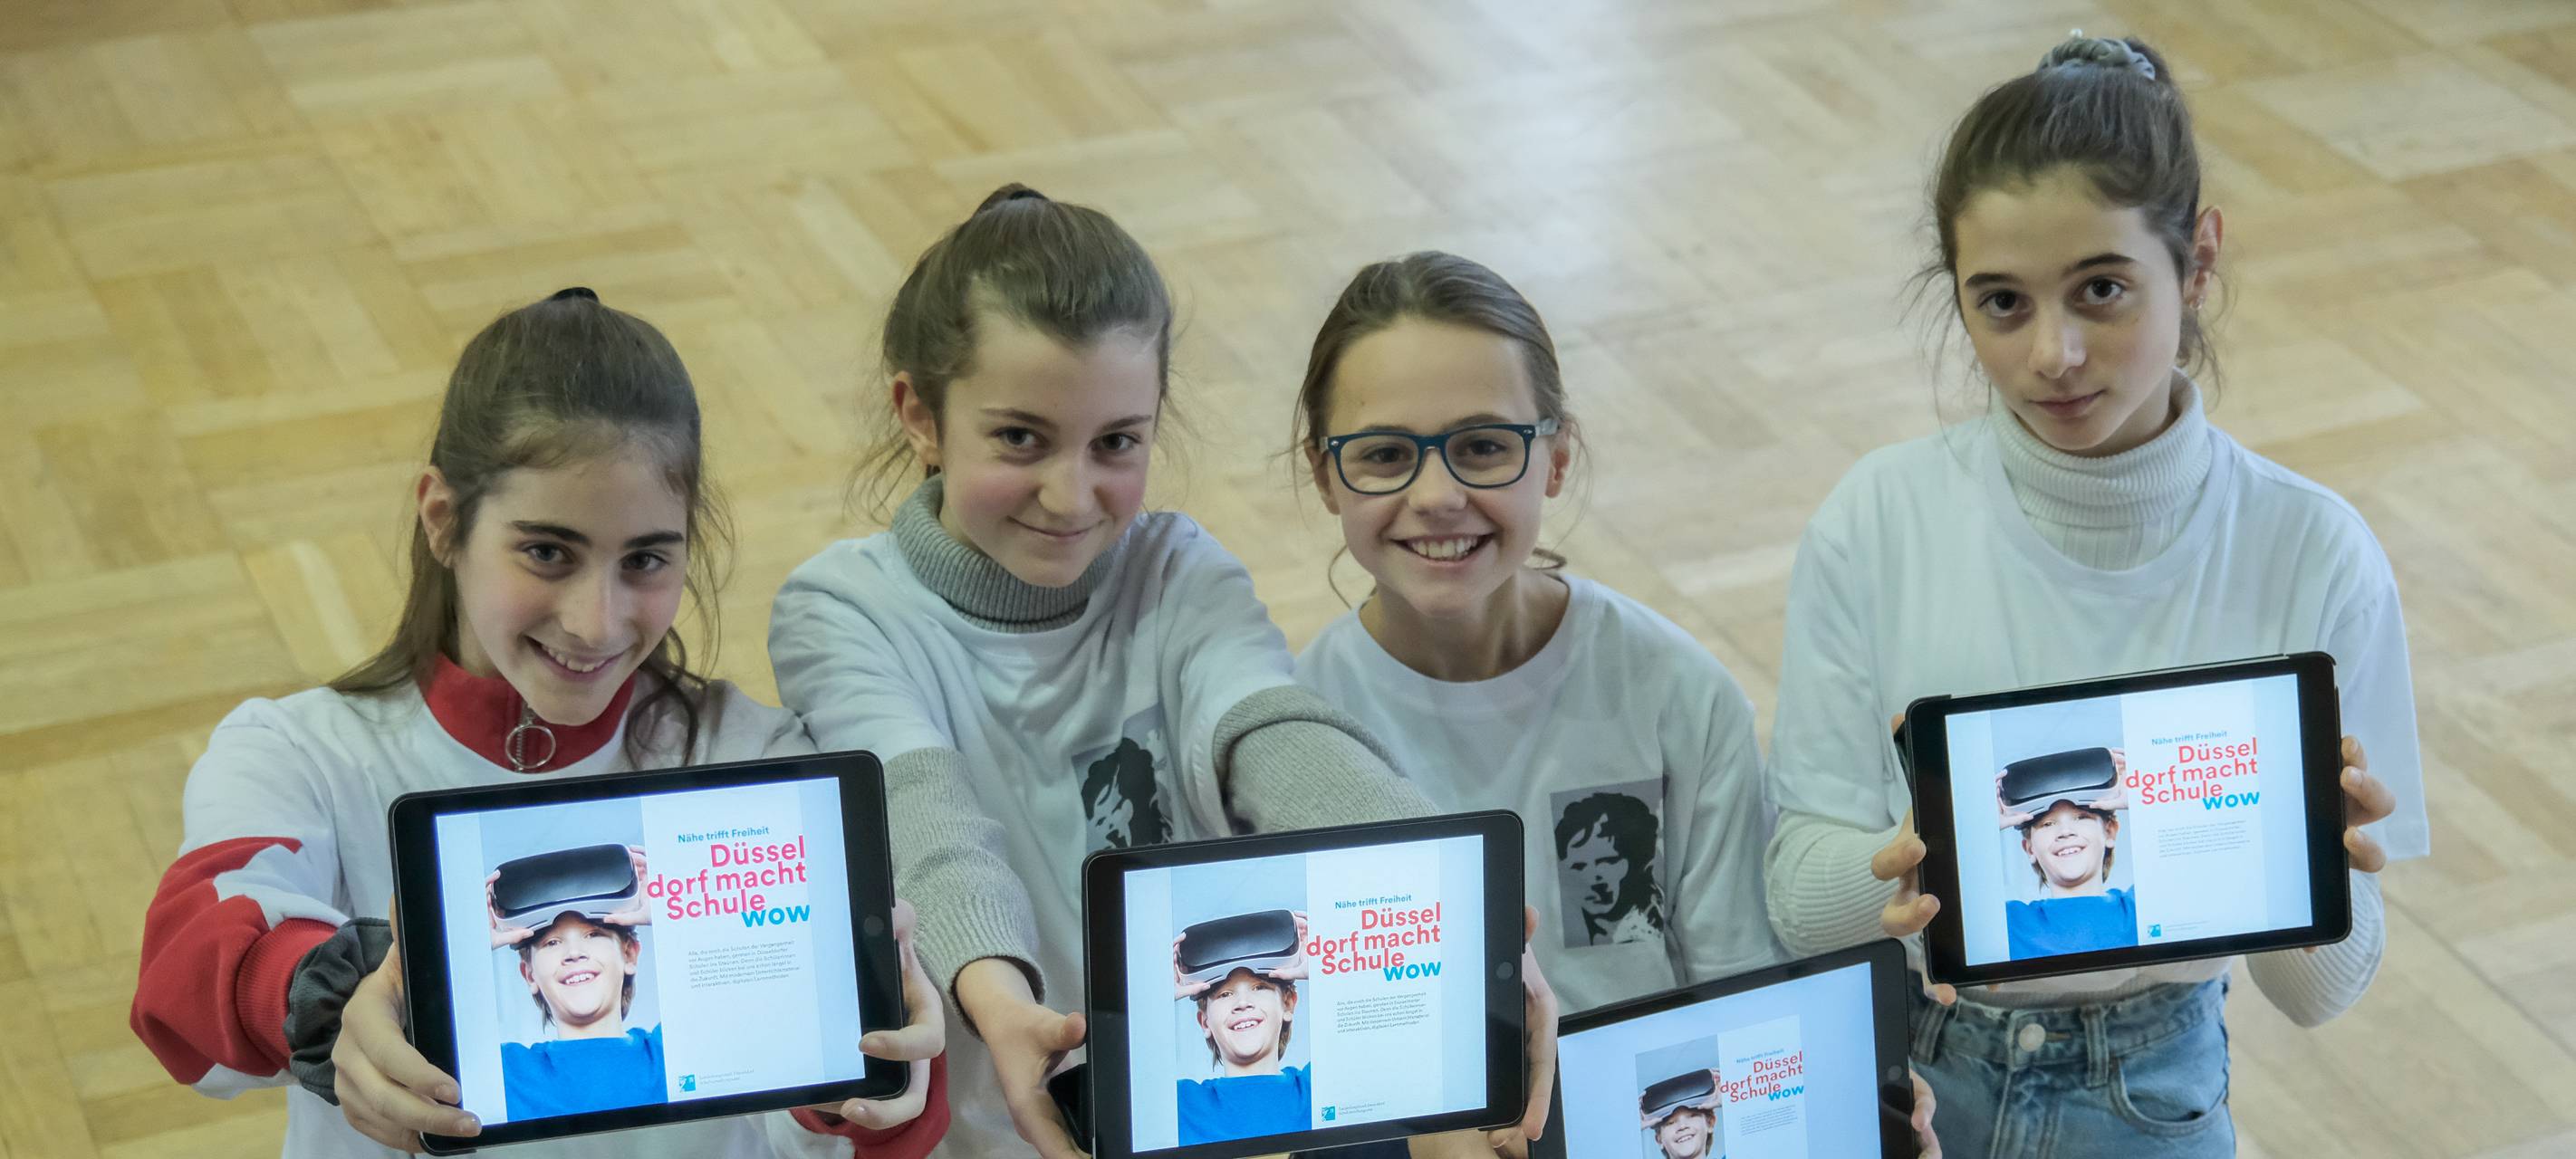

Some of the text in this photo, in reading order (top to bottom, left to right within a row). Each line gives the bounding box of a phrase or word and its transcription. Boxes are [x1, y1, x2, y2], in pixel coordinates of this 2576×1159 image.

[2175, 734, 2194, 742] trifft
[2196, 731, 2227, 740] Freiheit
[2178, 737, 2257, 763] Düssel
[2126, 758, 2257, 789] dorf macht
[2141, 780, 2223, 805] Schule
[2202, 791, 2260, 810] wow
[678, 827, 770, 843] Nähe trifft Freiheit
[710, 835, 805, 867] Düssel
[647, 861, 807, 898] dorf macht
[667, 889, 765, 920] Schule
[1335, 895, 1412, 909] Nähe trifft Freiheit
[741, 905, 811, 928] wow
[1361, 902, 1440, 930] Düssel
[1306, 924, 1440, 956] dorf macht
[1322, 948, 1404, 975] Schule
[1383, 962, 1441, 982] wow
[1754, 1050, 1802, 1073] Düssel
[1720, 1064, 1802, 1094] dorf macht
[1730, 1082, 1782, 1103] Schule
[1768, 1085, 1804, 1101] wow
